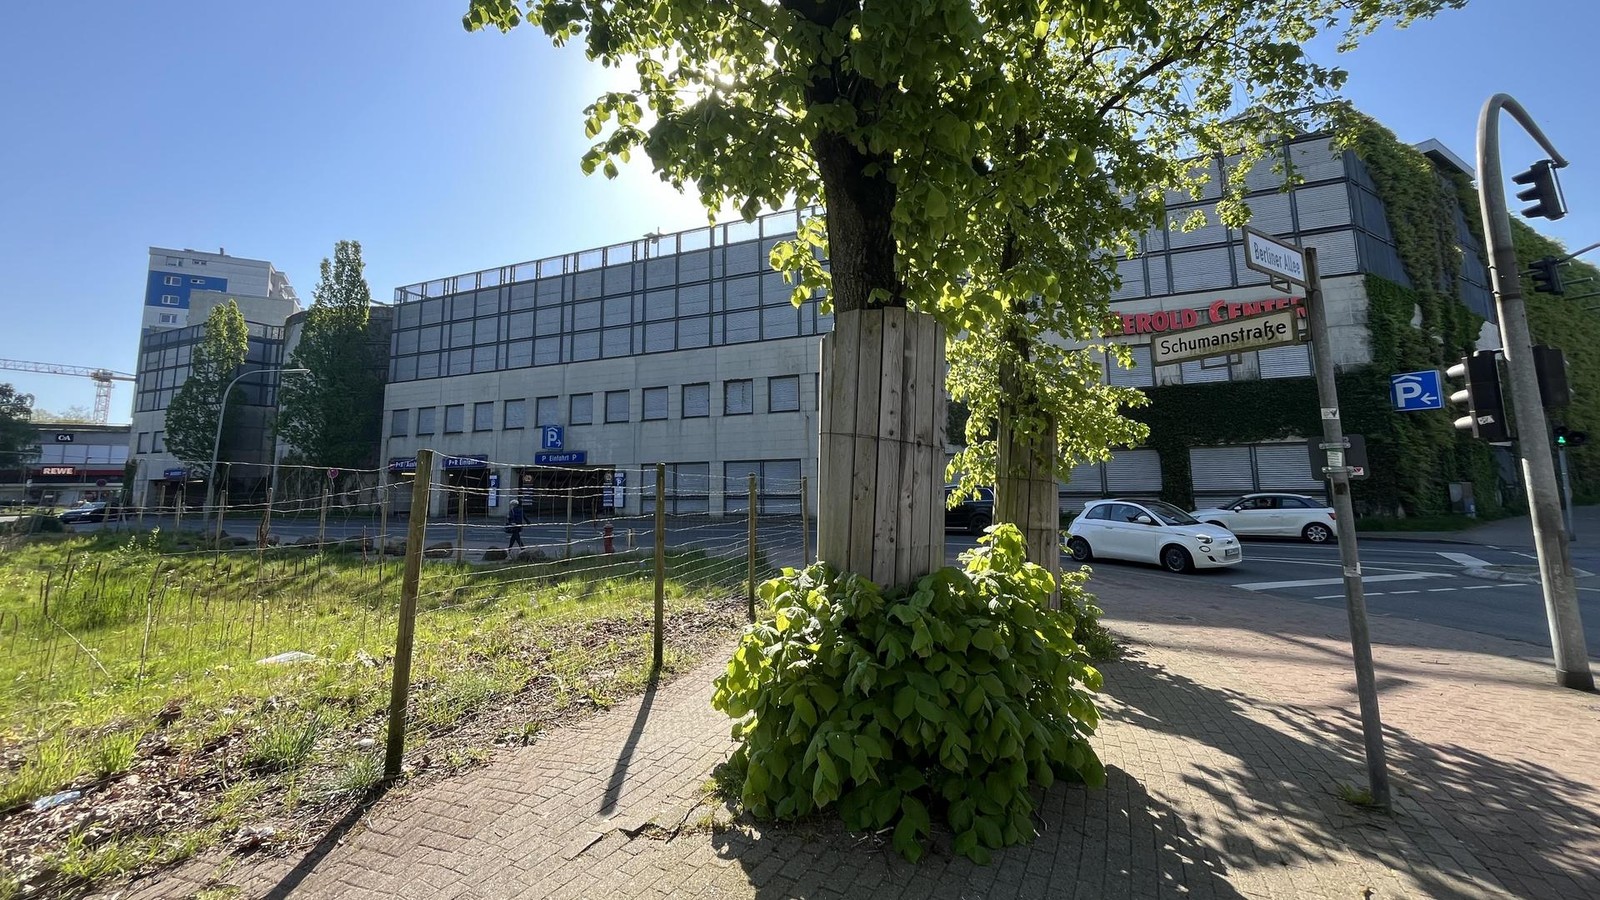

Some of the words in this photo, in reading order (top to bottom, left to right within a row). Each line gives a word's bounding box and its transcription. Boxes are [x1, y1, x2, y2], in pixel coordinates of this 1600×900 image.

[1253, 241, 1282, 268] Berliner
[1284, 254, 1301, 275] Allee
[1104, 308, 1199, 336] EROLD
[1160, 320, 1287, 355] Schumanstraße
[1395, 382, 1422, 408] P
[546, 431, 558, 447] P
[42, 467, 74, 475] REWE
